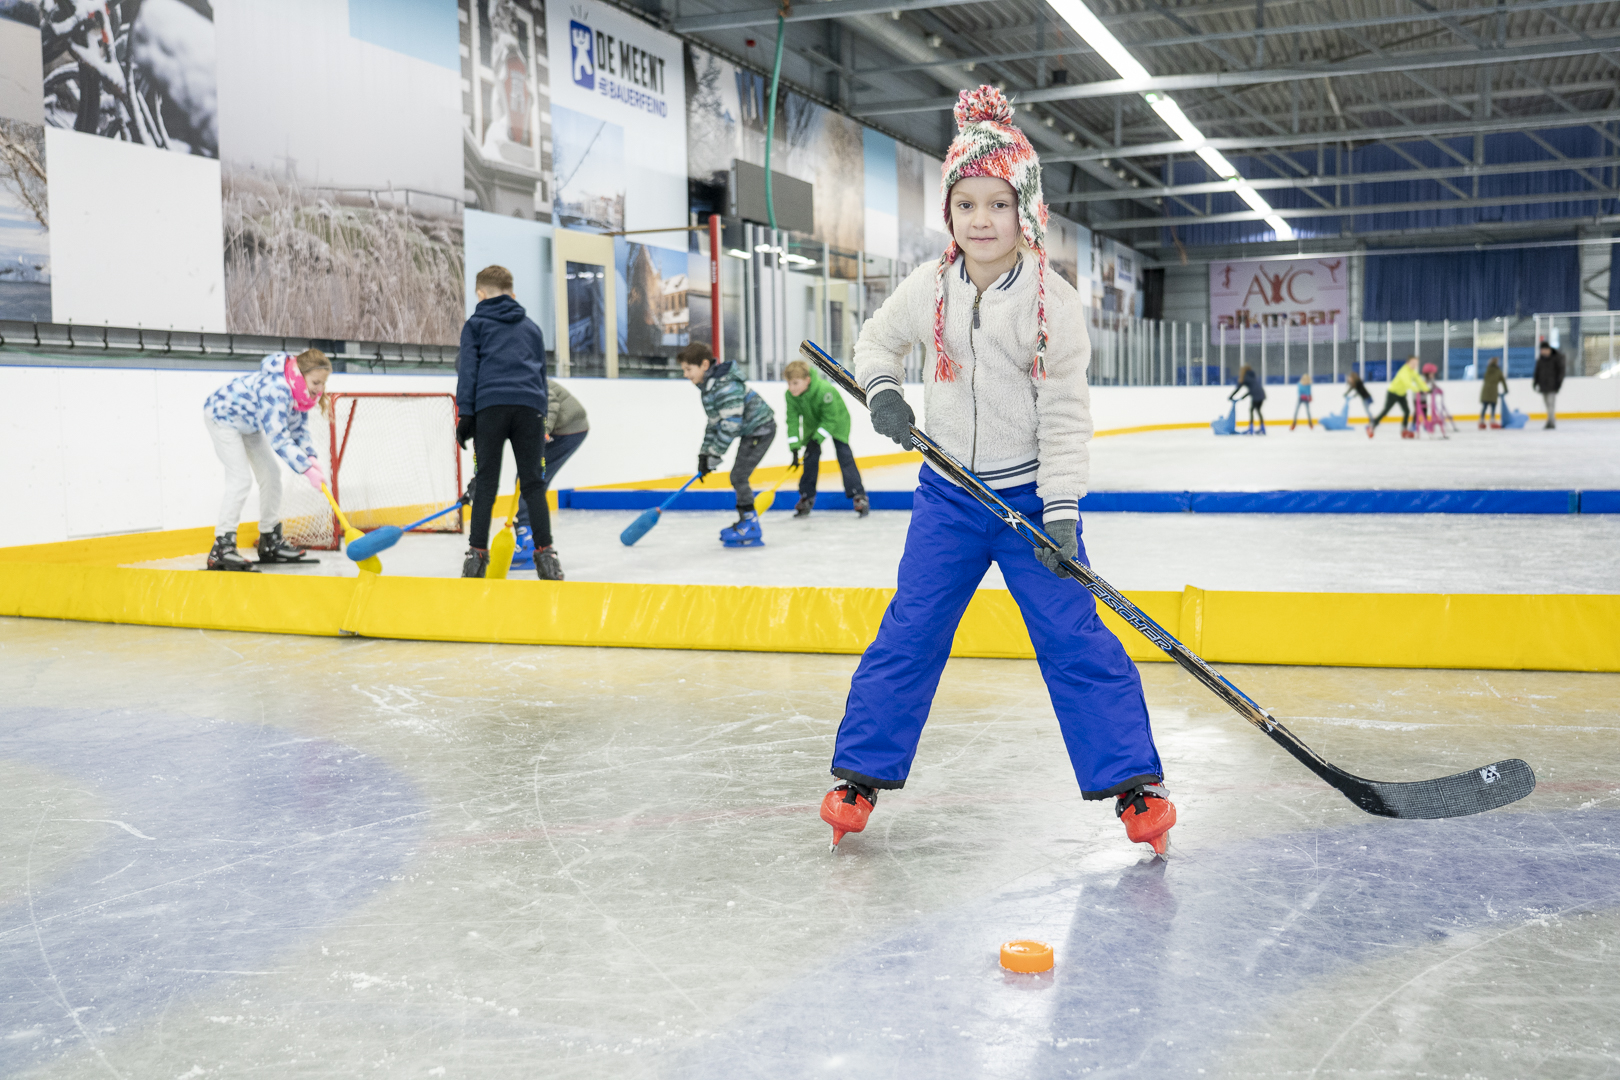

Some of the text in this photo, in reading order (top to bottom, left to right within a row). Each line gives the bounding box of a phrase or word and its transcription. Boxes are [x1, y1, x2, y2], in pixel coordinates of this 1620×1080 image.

[596, 30, 665, 95] DE MEENT
[610, 80, 668, 118] BAUERFEIND
[1217, 309, 1340, 330] alkmaar
[1085, 582, 1172, 652] FISCHER
